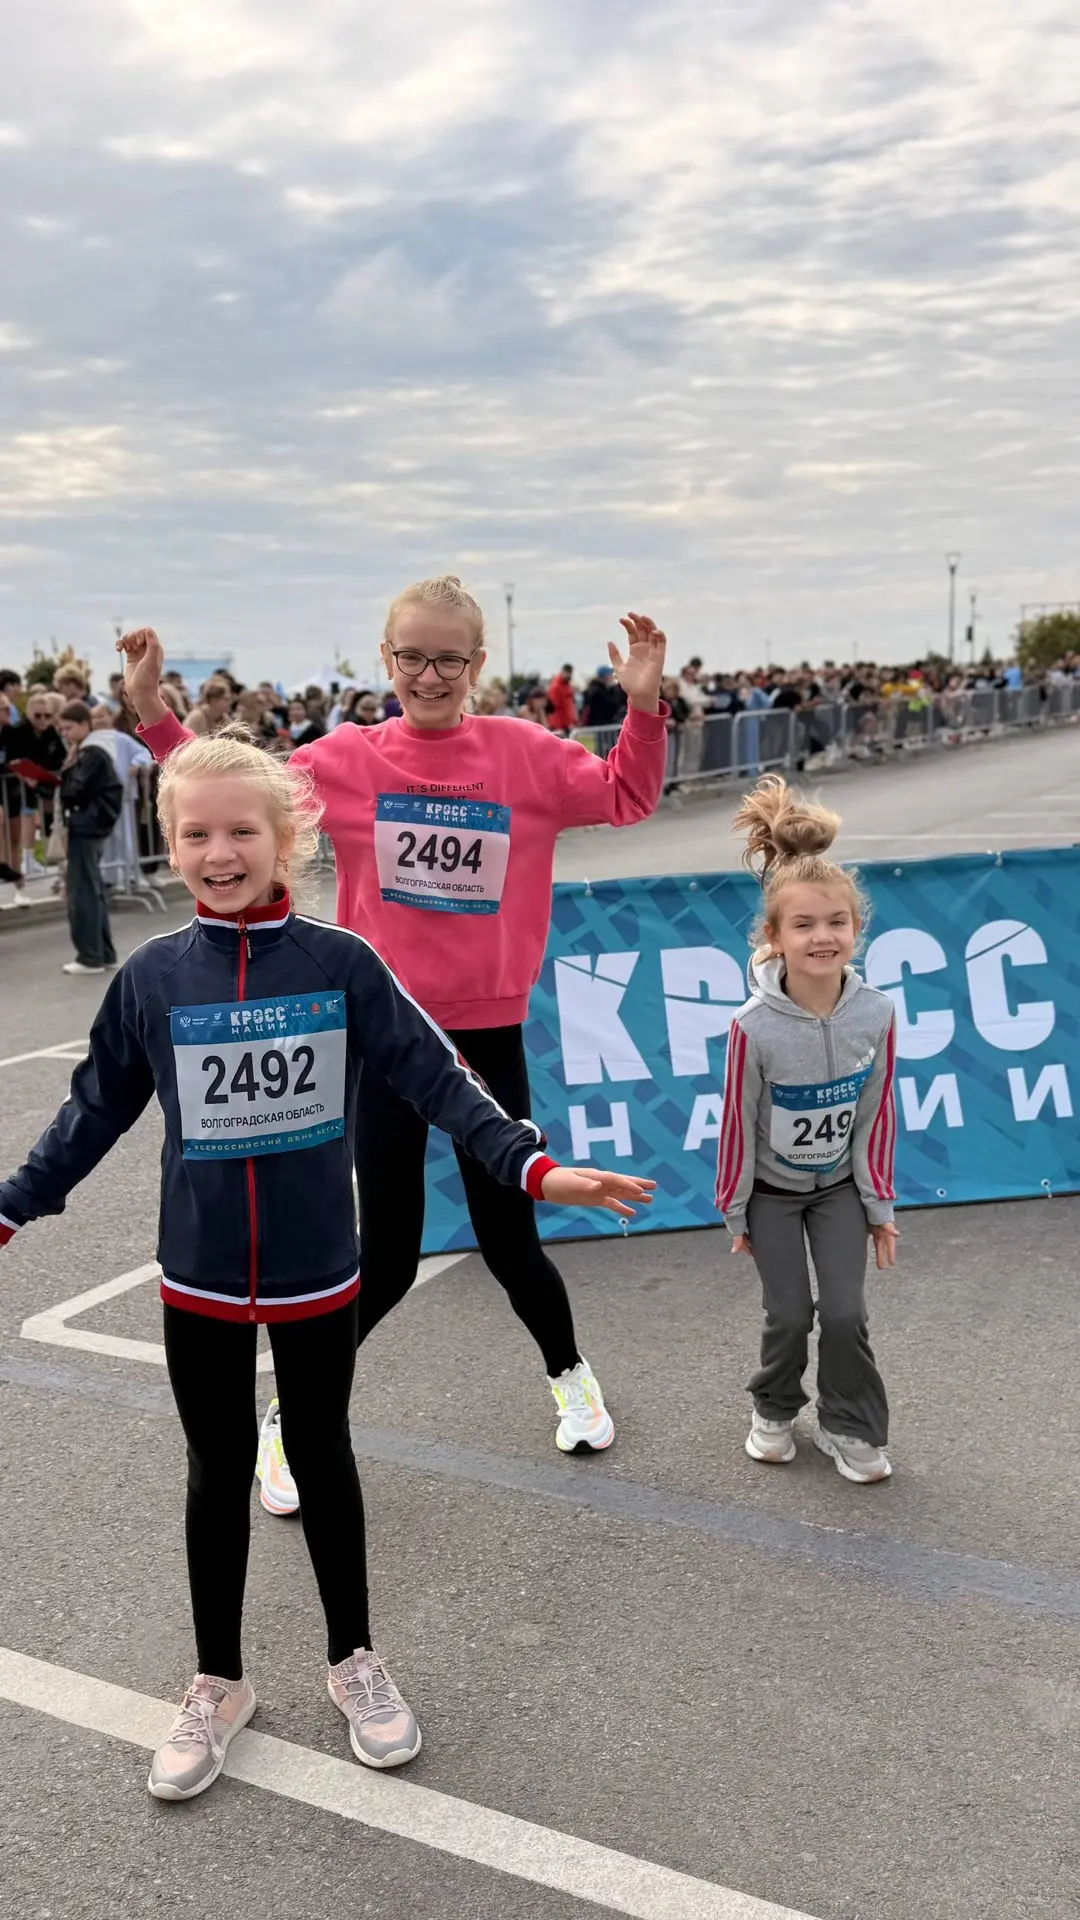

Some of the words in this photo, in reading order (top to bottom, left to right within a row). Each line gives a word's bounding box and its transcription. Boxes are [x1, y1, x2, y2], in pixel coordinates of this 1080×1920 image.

[430, 782, 485, 792] DIFFERENT
[425, 814, 467, 823] НАЦИИ
[426, 803, 468, 817] КРОСС
[397, 831, 483, 874] 2494
[395, 875, 452, 891] ВОЛГОГРАДСКАЯ
[452, 883, 485, 893] ОБЛАСТЬ
[554, 919, 1056, 1086] КРСС
[230, 1006, 286, 1026] КРОСС
[231, 1022, 287, 1034] НАЦИИ
[201, 1045, 317, 1105] 2492
[816, 1081, 856, 1099] КРОСС
[817, 1091, 857, 1104] НАЦИИ
[201, 1111, 284, 1129] ВОЛГОГРАДСКАЯ
[286, 1103, 325, 1121] ОБЛАСТЬ
[567, 1063, 1075, 1161] НАИИ
[792, 1110, 854, 1147] 249
